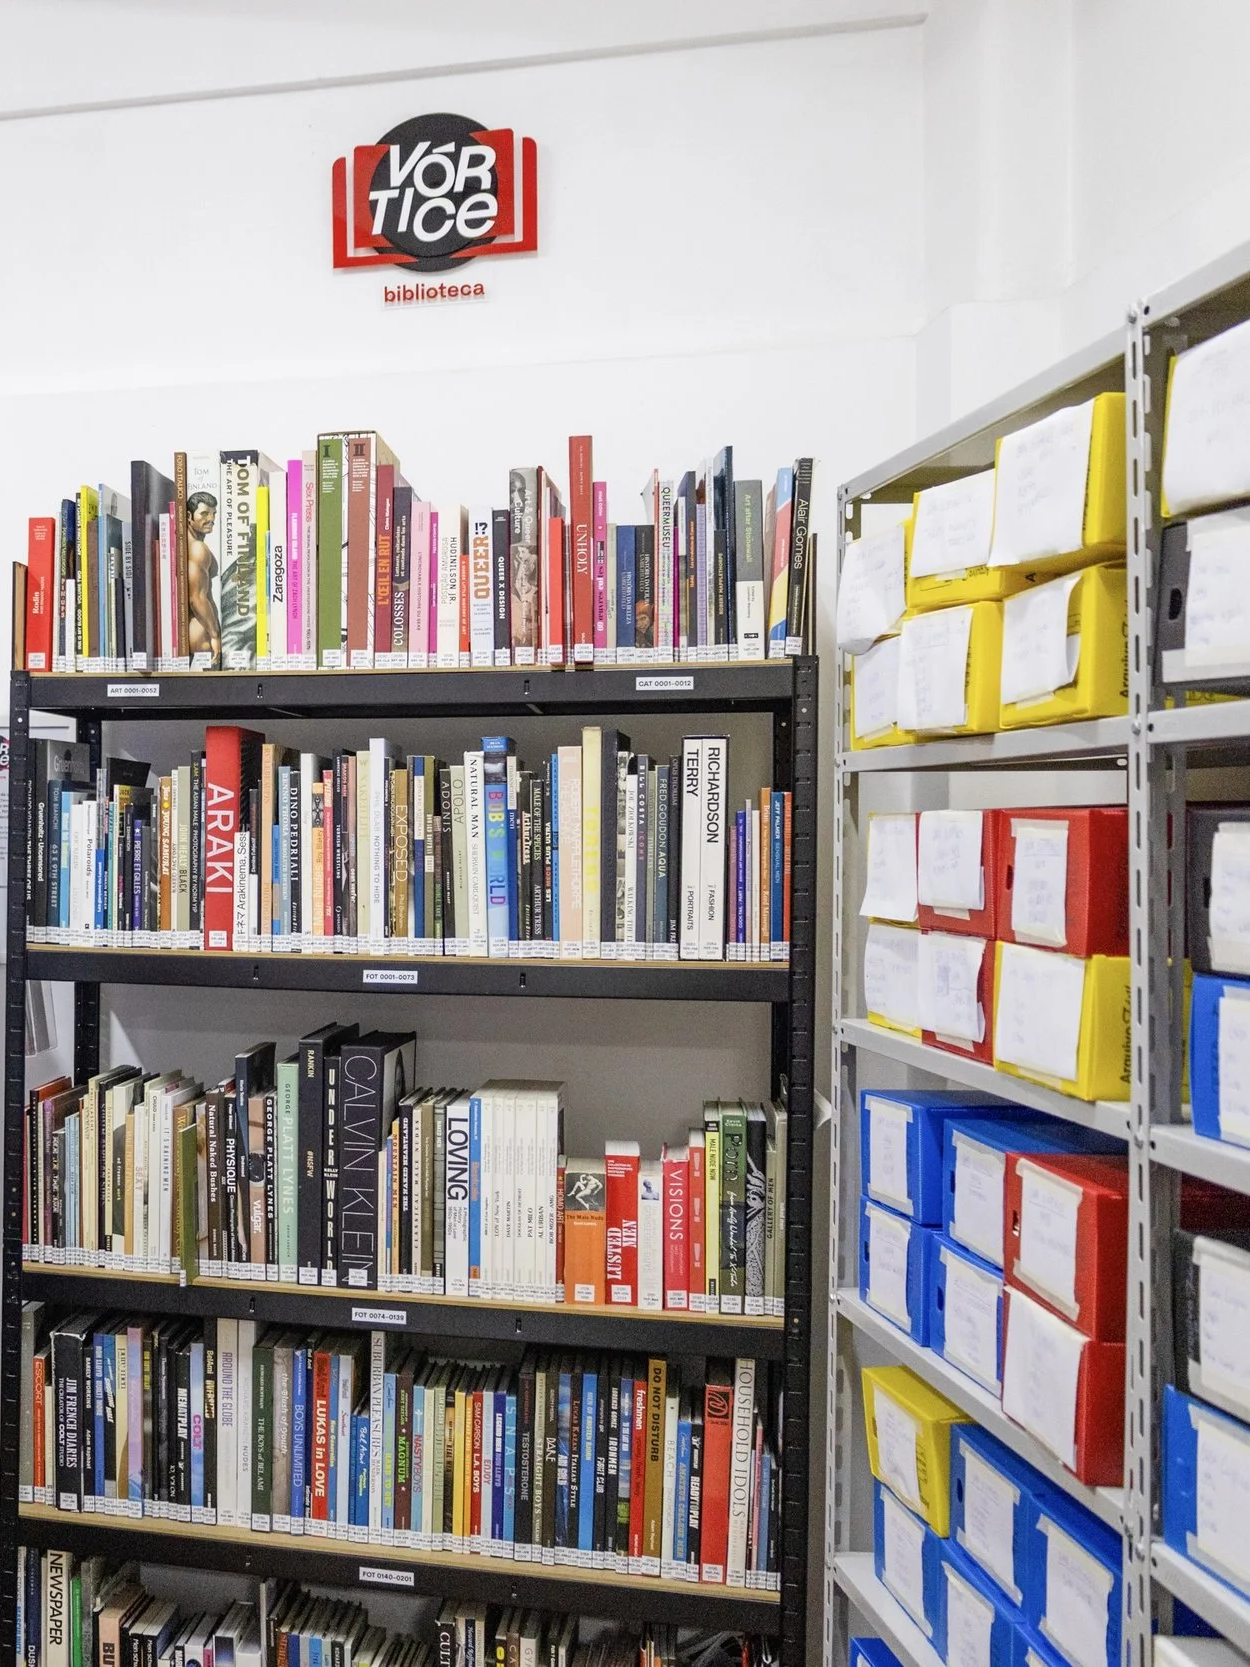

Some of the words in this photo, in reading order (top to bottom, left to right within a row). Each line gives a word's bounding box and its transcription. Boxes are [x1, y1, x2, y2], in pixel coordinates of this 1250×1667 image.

[384, 282, 485, 302] biblioteca
[237, 456, 250, 496] TOM
[305, 482, 314, 497] Sex
[226, 498, 233, 509] OF
[237, 502, 250, 526] OF
[305, 499, 314, 522] Press
[514, 500, 522, 534] Culture
[662, 487, 671, 548] QUEERMUSEU
[797, 499, 808, 523] Alair
[379, 535, 390, 555] RUT
[379, 557, 390, 572] EN
[449, 537, 457, 589] HUDINILSON
[577, 524, 587, 574] UNHOLY
[794, 526, 807, 569] Gomes
[237, 532, 250, 616] FINLAND
[273, 546, 284, 602] Zaragoza
[473, 536, 490, 599] QUEER
[449, 593, 457, 604] JR.
[394, 592, 405, 646] COLOSSES
[470, 760, 478, 809] NATURAL
[686, 749, 698, 797] TERRY
[290, 788, 298, 819] DINO
[442, 781, 451, 832] ADONIS
[453, 779, 465, 824] APOLO
[488, 792, 505, 837] BOB'S
[706, 747, 720, 843] RICHARDSON
[179, 824, 187, 842] JOHN
[206, 783, 234, 894] ARAKI
[395, 805, 407, 881] EXPOSED
[471, 814, 479, 838] MAN
[134, 863, 141, 871] ET
[179, 845, 187, 867] HEALY
[290, 824, 298, 880] PEDRIALI
[179, 869, 187, 893] BLACK
[374, 874, 380, 883] TO
[686, 891, 694, 930] PORTRAITS
[306, 1050, 314, 1078] RANKIN
[208, 1105, 216, 1137] Natural
[342, 1055, 377, 1171] CALVIN
[209, 1141, 217, 1168] Naked
[282, 1117, 293, 1161] PLATT
[447, 1117, 468, 1200] LOVING
[725, 1133, 743, 1180] Porn
[226, 1138, 236, 1193] PHYSIQUE
[306, 1151, 314, 1177] #NSFW
[209, 1171, 218, 1202] Bushes
[282, 1168, 294, 1213] LYNES
[669, 1170, 683, 1240] VISIONS
[767, 1196, 774, 1205] OF
[252, 1200, 262, 1233] vulgar.
[341, 1188, 374, 1284] KLEIN
[622, 1219, 637, 1248] MEN
[607, 1227, 622, 1280] LUSTED
[66, 1378, 77, 1392] JIM
[222, 1352, 233, 1384] AROUND
[371, 1337, 382, 1394] SUBURBAN
[653, 1368, 661, 1383] DO
[66, 1396, 77, 1429] FRENCH
[222, 1387, 233, 1400] THE
[636, 1390, 645, 1429] freshmen
[652, 1387, 661, 1410] NOT
[735, 1359, 753, 1462] HOUSEHOLD
[177, 1388, 187, 1439] MENATPLAY
[193, 1414, 201, 1449] COLT
[222, 1403, 233, 1426] GLOBE
[294, 1405, 304, 1432] BOYS
[316, 1400, 326, 1444] LUKAS
[371, 1397, 382, 1457] PLEASURES
[66, 1432, 77, 1468] DIARIES
[315, 1448, 326, 1458] in
[546, 1438, 556, 1462] DARE
[608, 1437, 617, 1475] IRONMEN
[651, 1413, 660, 1461] DISTURB
[293, 1434, 304, 1486] UNLIMITED
[398, 1436, 406, 1483] MAGNUM
[413, 1434, 422, 1493] NASTYBOYS
[521, 1432, 529, 1500] TESTOSTERONE
[534, 1439, 543, 1486] STRAIGHT
[666, 1440, 675, 1477] BEACH
[315, 1463, 326, 1496] LOVE
[732, 1469, 748, 1517] IDOLS
[534, 1490, 543, 1514] BOYS
[689, 1476, 700, 1529] READYTOPLAY
[377, 1573, 412, 1582] 0140-0201
[49, 1553, 63, 1645] NEWSPAPER
